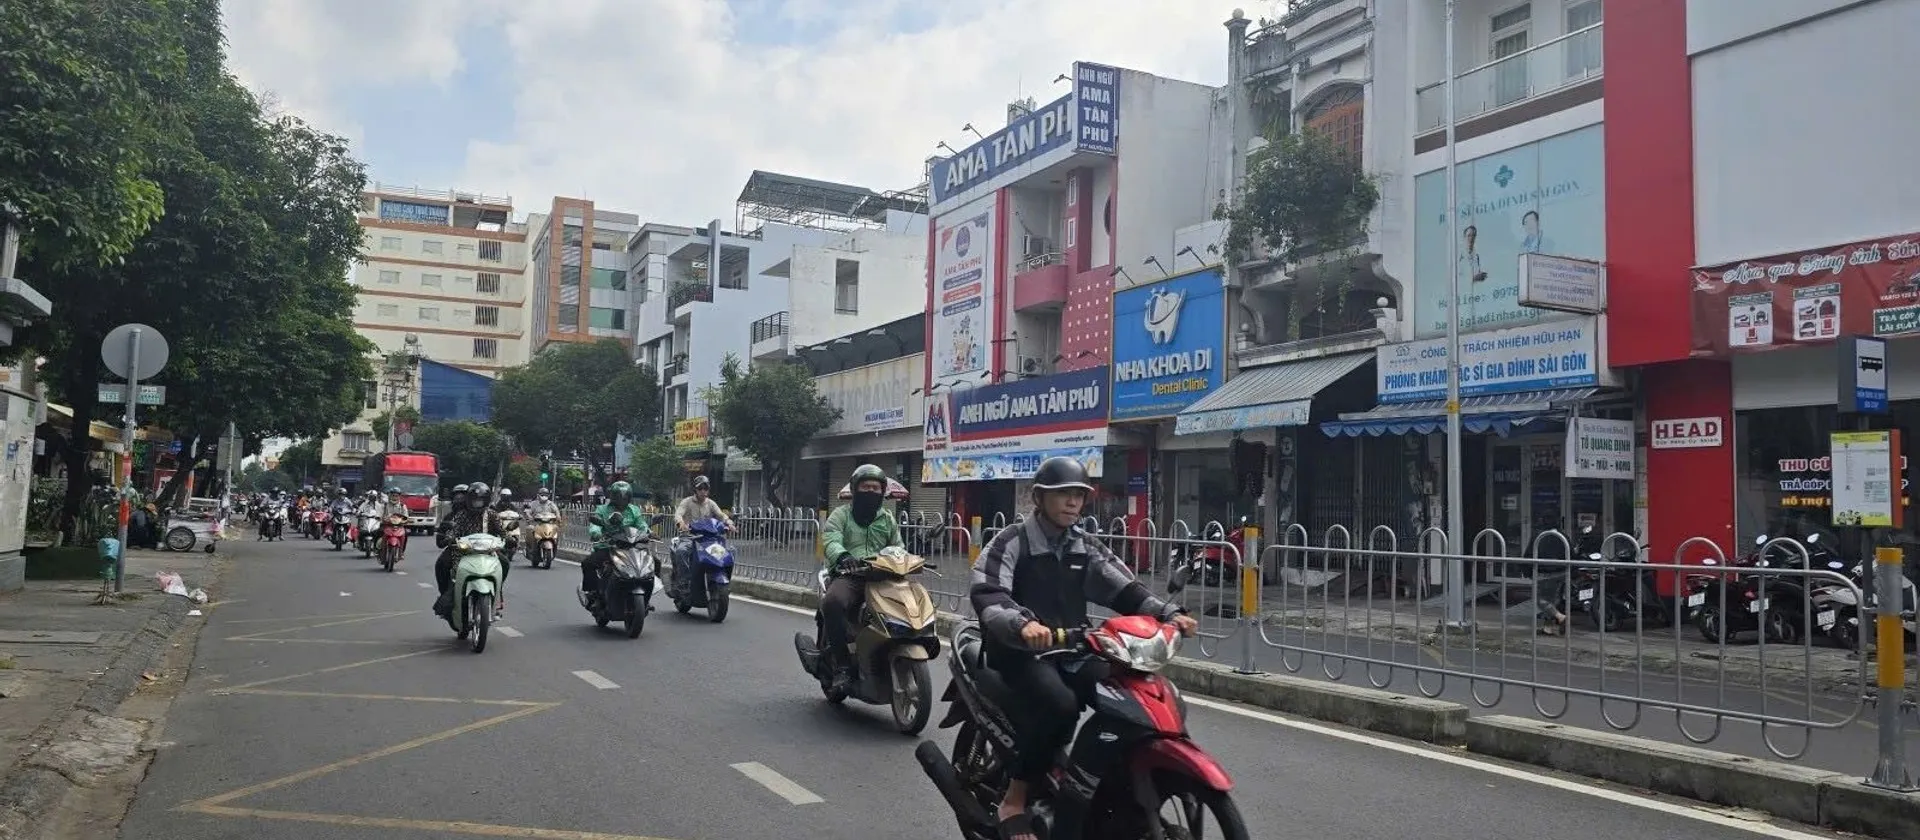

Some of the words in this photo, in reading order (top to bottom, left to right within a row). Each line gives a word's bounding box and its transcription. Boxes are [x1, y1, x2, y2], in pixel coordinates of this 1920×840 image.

[1079, 68, 1096, 82] ANH
[1081, 86, 1111, 104] AMA
[1083, 105, 1109, 124] TÂN
[1082, 125, 1109, 143] PHÚ
[944, 145, 988, 192] AMA
[1041, 99, 1073, 145] PH
[1849, 243, 1882, 266] sinh
[1420, 345, 1447, 359] CÔNG
[1463, 337, 1495, 353] TRÁCH
[1497, 334, 1530, 349] NHIỆM
[1558, 329, 1581, 343] HẠN
[1115, 358, 1148, 383] NHA
[1147, 350, 1192, 378] KHOA
[1194, 347, 1212, 371] DI
[1384, 370, 1417, 390] PHÒNG
[1419, 366, 1447, 387] KHÁM
[1486, 361, 1505, 380] GIA
[1507, 356, 1535, 377] ĐÌNH
[1538, 353, 1558, 374] SÀI
[1561, 350, 1587, 372] GÒN
[1151, 379, 1181, 396] Dental
[1181, 376, 1209, 393] Clinic
[958, 403, 983, 425] ANH
[1009, 395, 1038, 419] AMA
[1039, 386, 1067, 415] TÂN
[1068, 379, 1100, 411] PHÚ
[1655, 421, 1718, 439] HEAD
[1590, 437, 1613, 452] QUANG
[1779, 458, 1808, 472] THU
[1809, 456, 1832, 472] CŨ
[1780, 477, 1802, 490] TRẢ
[1802, 477, 1826, 490] GÓP
